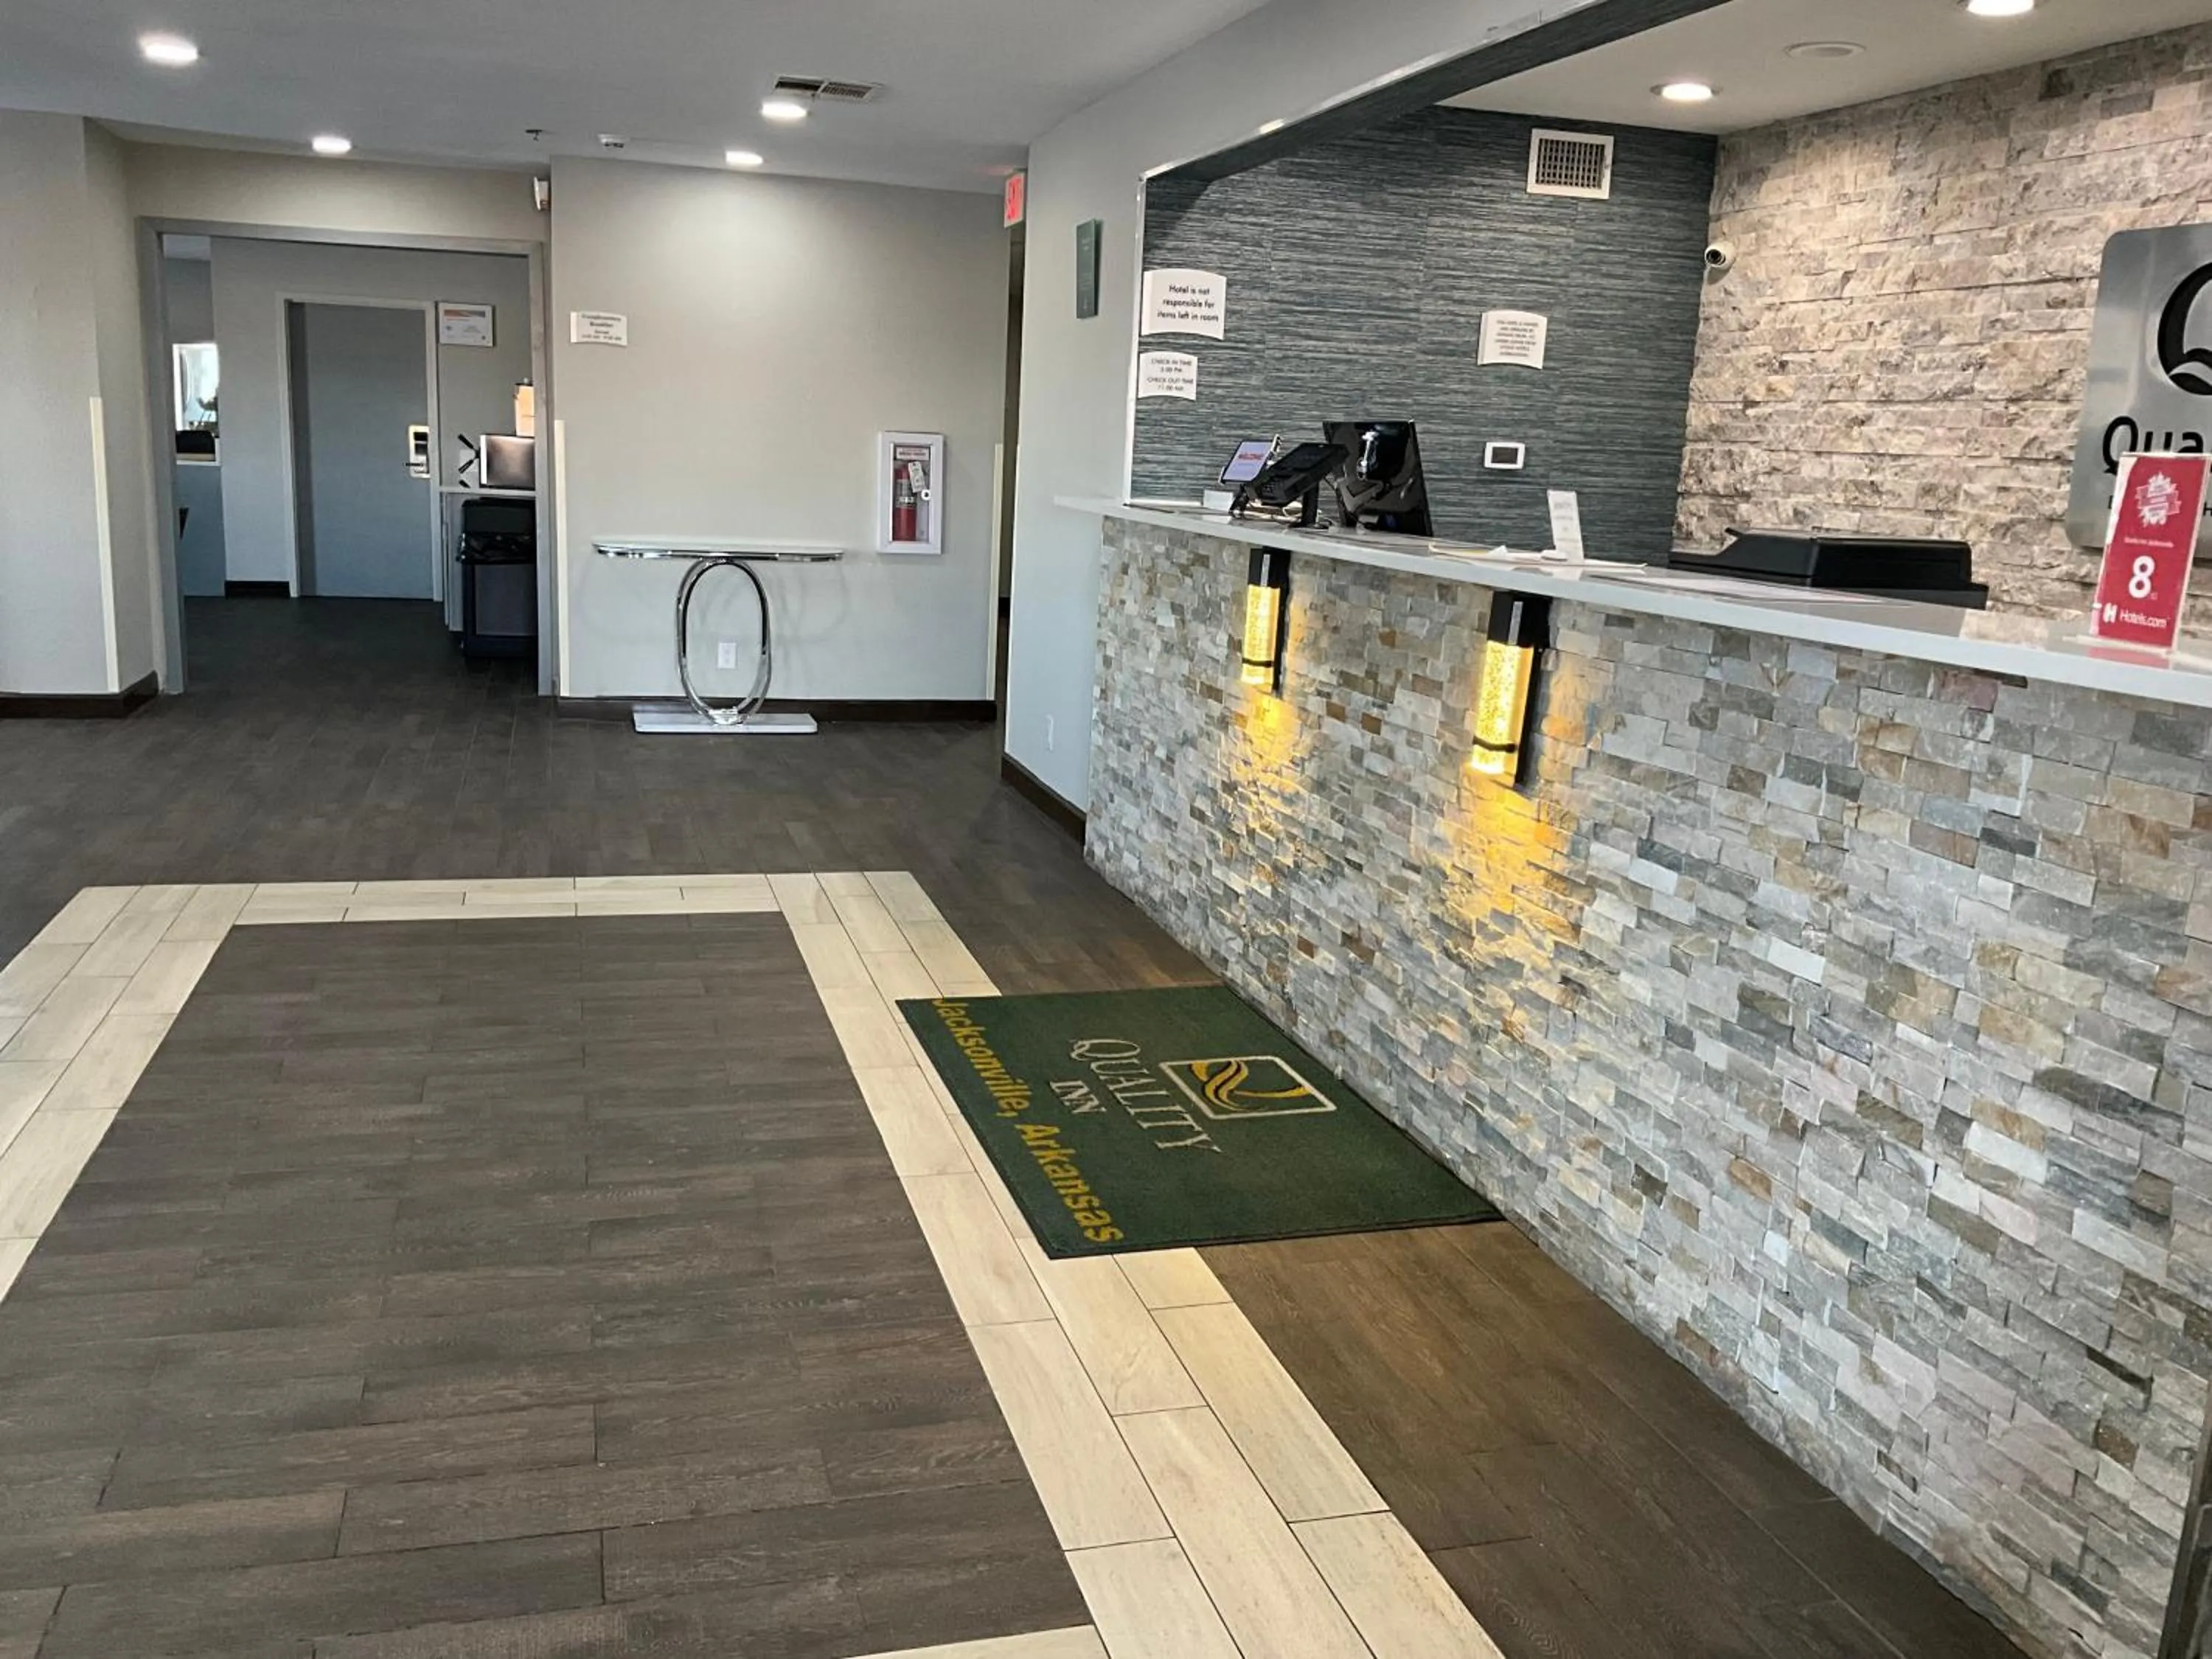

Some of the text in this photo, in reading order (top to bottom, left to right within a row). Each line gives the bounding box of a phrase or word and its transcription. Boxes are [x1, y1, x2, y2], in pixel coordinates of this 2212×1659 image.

[1169, 285, 1189, 293] Hotel
[1157, 310, 1176, 319] items
[1178, 310, 1189, 319] left
[1200, 314, 1219, 322] room
[1163, 299, 1214, 308] responsible for
[2128, 554, 2155, 599] 8
[2119, 608, 2168, 629] Hotels.com
[1049, 1079, 1107, 1115] INN
[1071, 1038, 1222, 1153] QUALITY
[932, 995, 1125, 1242] Jacksonville, Arkansas
